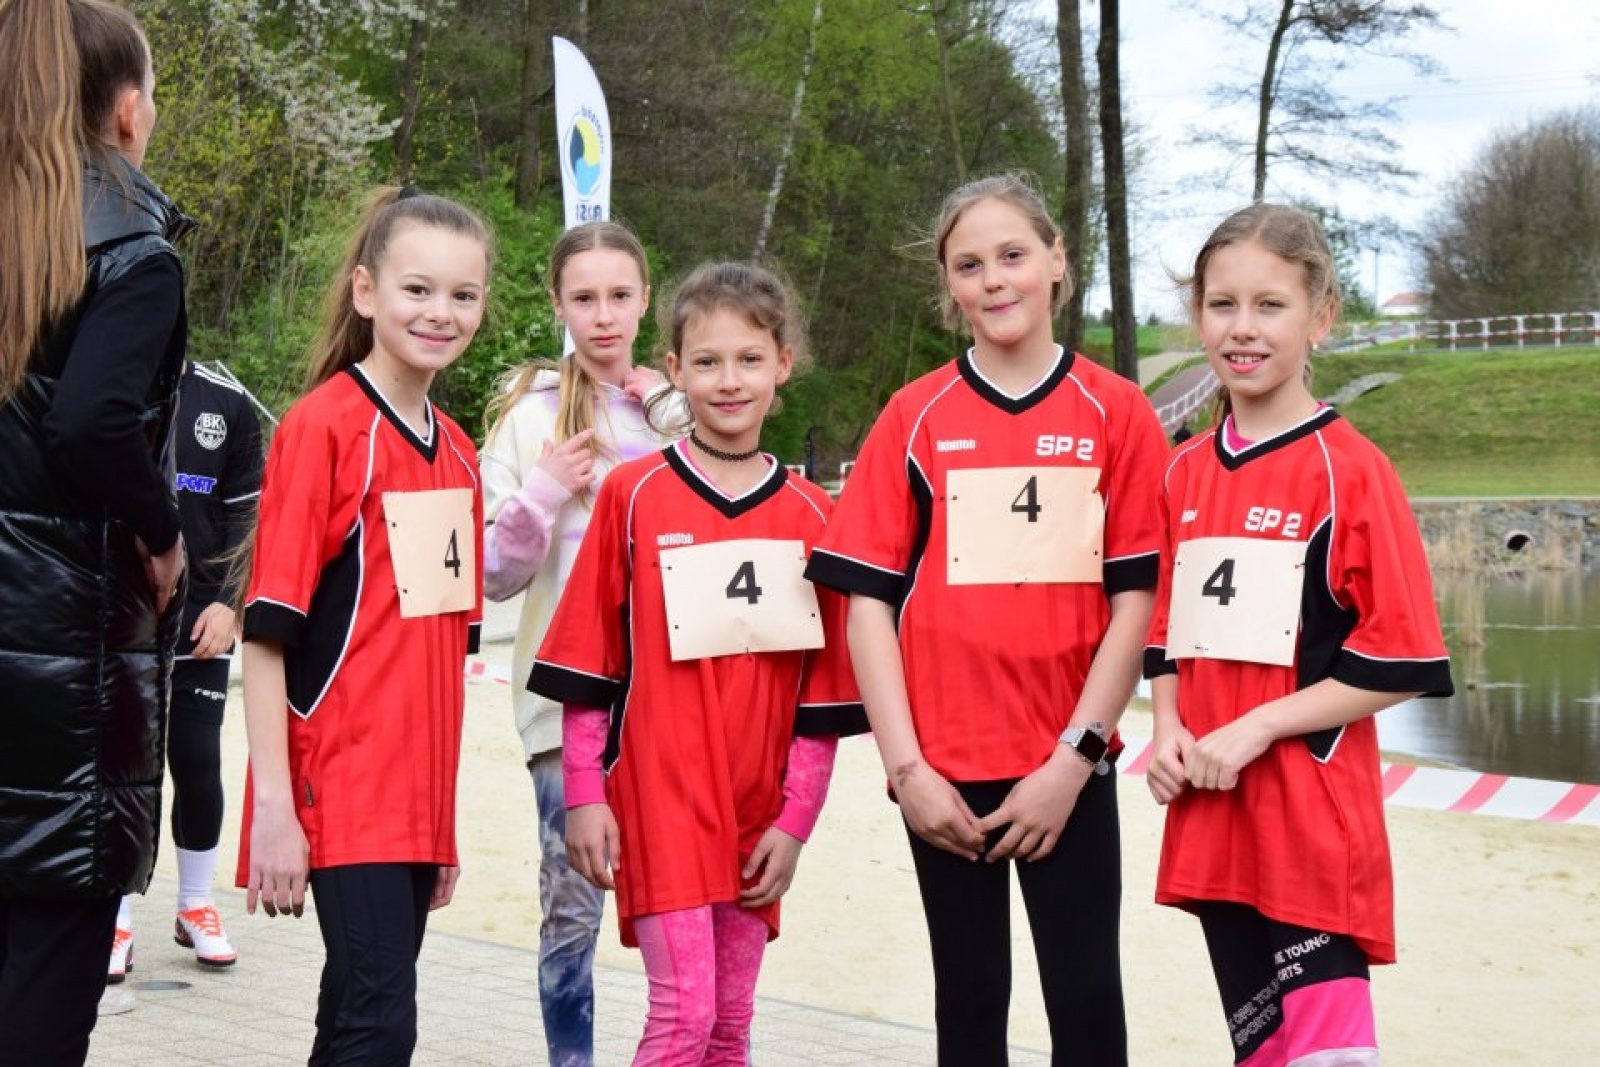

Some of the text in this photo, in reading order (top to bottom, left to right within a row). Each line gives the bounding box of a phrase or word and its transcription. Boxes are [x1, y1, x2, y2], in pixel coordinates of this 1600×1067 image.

[203, 415, 221, 430] BK
[1036, 434, 1095, 461] SP 2
[1011, 474, 1042, 523] 4
[1244, 506, 1303, 538] SP 2
[444, 527, 461, 578] 4
[725, 560, 763, 605] 4
[1201, 558, 1237, 606] 4
[1284, 932, 1331, 960] YOUNG
